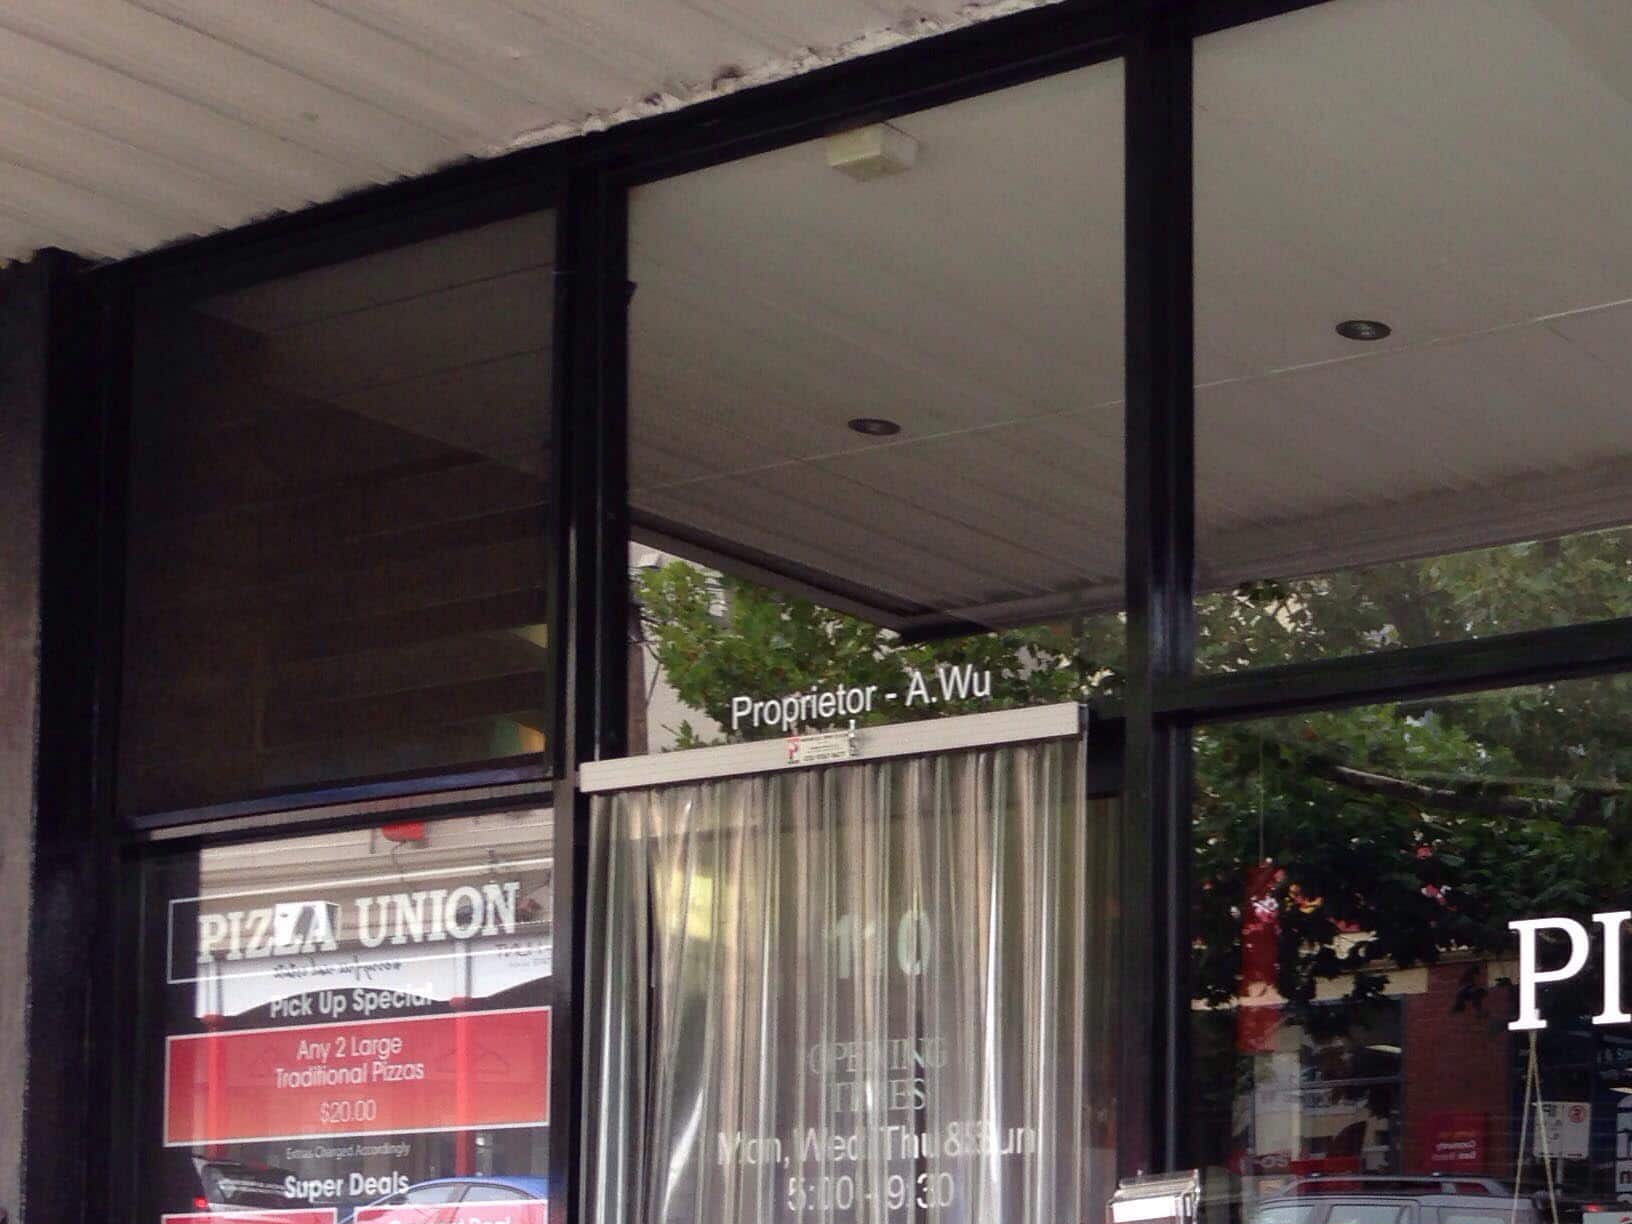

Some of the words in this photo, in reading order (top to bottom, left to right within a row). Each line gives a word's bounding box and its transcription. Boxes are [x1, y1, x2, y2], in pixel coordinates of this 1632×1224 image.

[731, 683, 878, 733] Proprietor
[905, 664, 992, 707] A.Wu
[197, 901, 340, 963] PIZZA
[354, 881, 521, 948] UNION
[270, 991, 312, 1018] Pick
[319, 989, 347, 1017] Up
[298, 1037, 330, 1061] Any
[335, 1036, 345, 1057] 2
[352, 1036, 403, 1060] Large
[275, 1066, 368, 1088] Traditional
[373, 1061, 424, 1083] Pizzas
[835, 1077, 926, 1113] TIES
[319, 1100, 377, 1125] $20.00
[284, 1175, 345, 1204] Super
[349, 1170, 410, 1196] Deals
